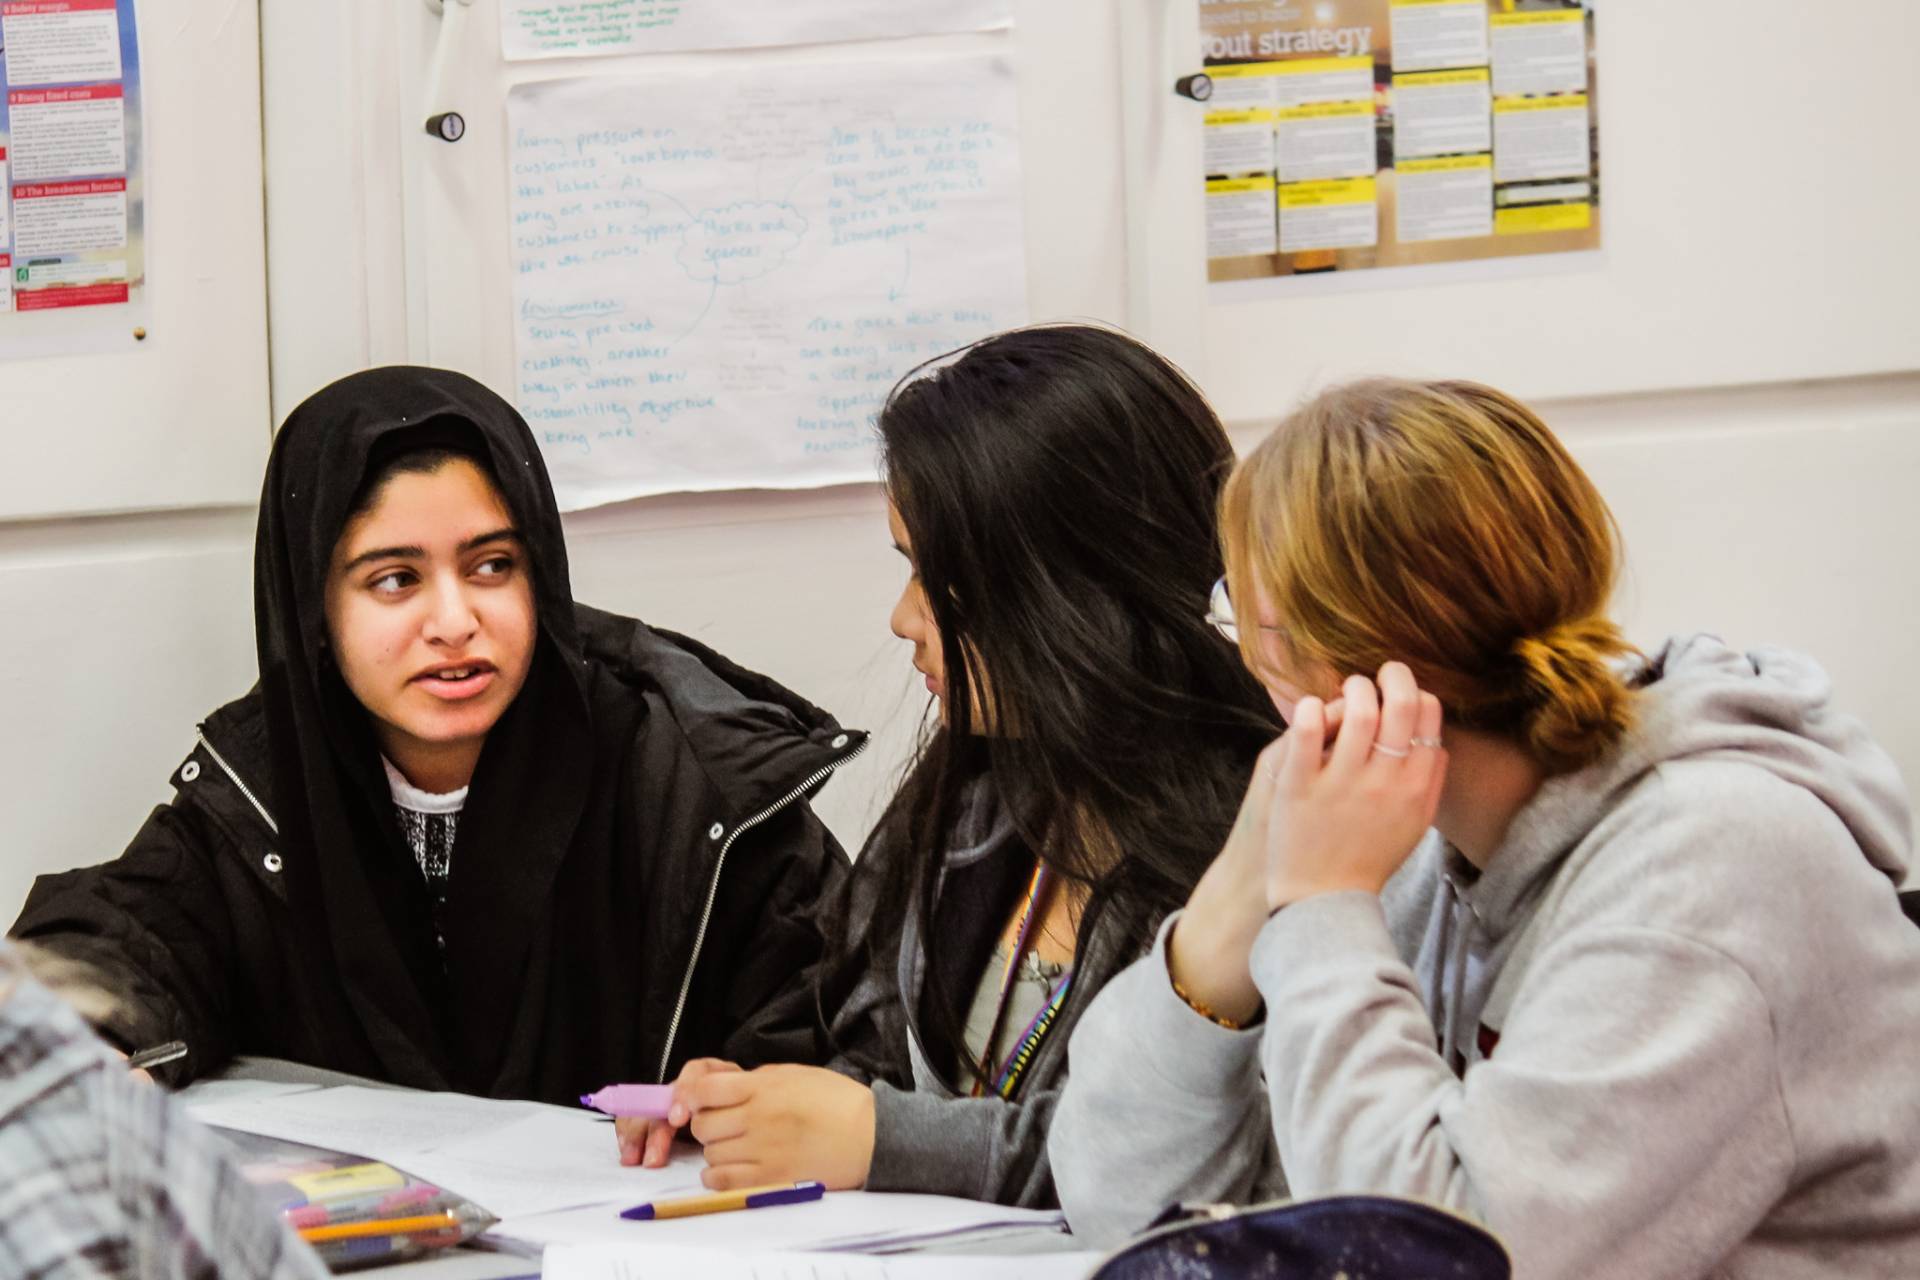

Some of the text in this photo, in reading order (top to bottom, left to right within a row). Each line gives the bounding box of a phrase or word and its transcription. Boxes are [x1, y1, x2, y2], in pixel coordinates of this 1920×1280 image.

[1259, 25, 1372, 58] strategy
[46, 90, 68, 100] fixed
[576, 128, 645, 154] pressure
[515, 157, 597, 174] customers
[27, 186, 43, 196] The
[560, 202, 584, 216] are
[517, 226, 598, 249] customers
[607, 344, 670, 361] another
[545, 428, 591, 456] being
[1007, 1001, 1058, 1078] STUDENT
